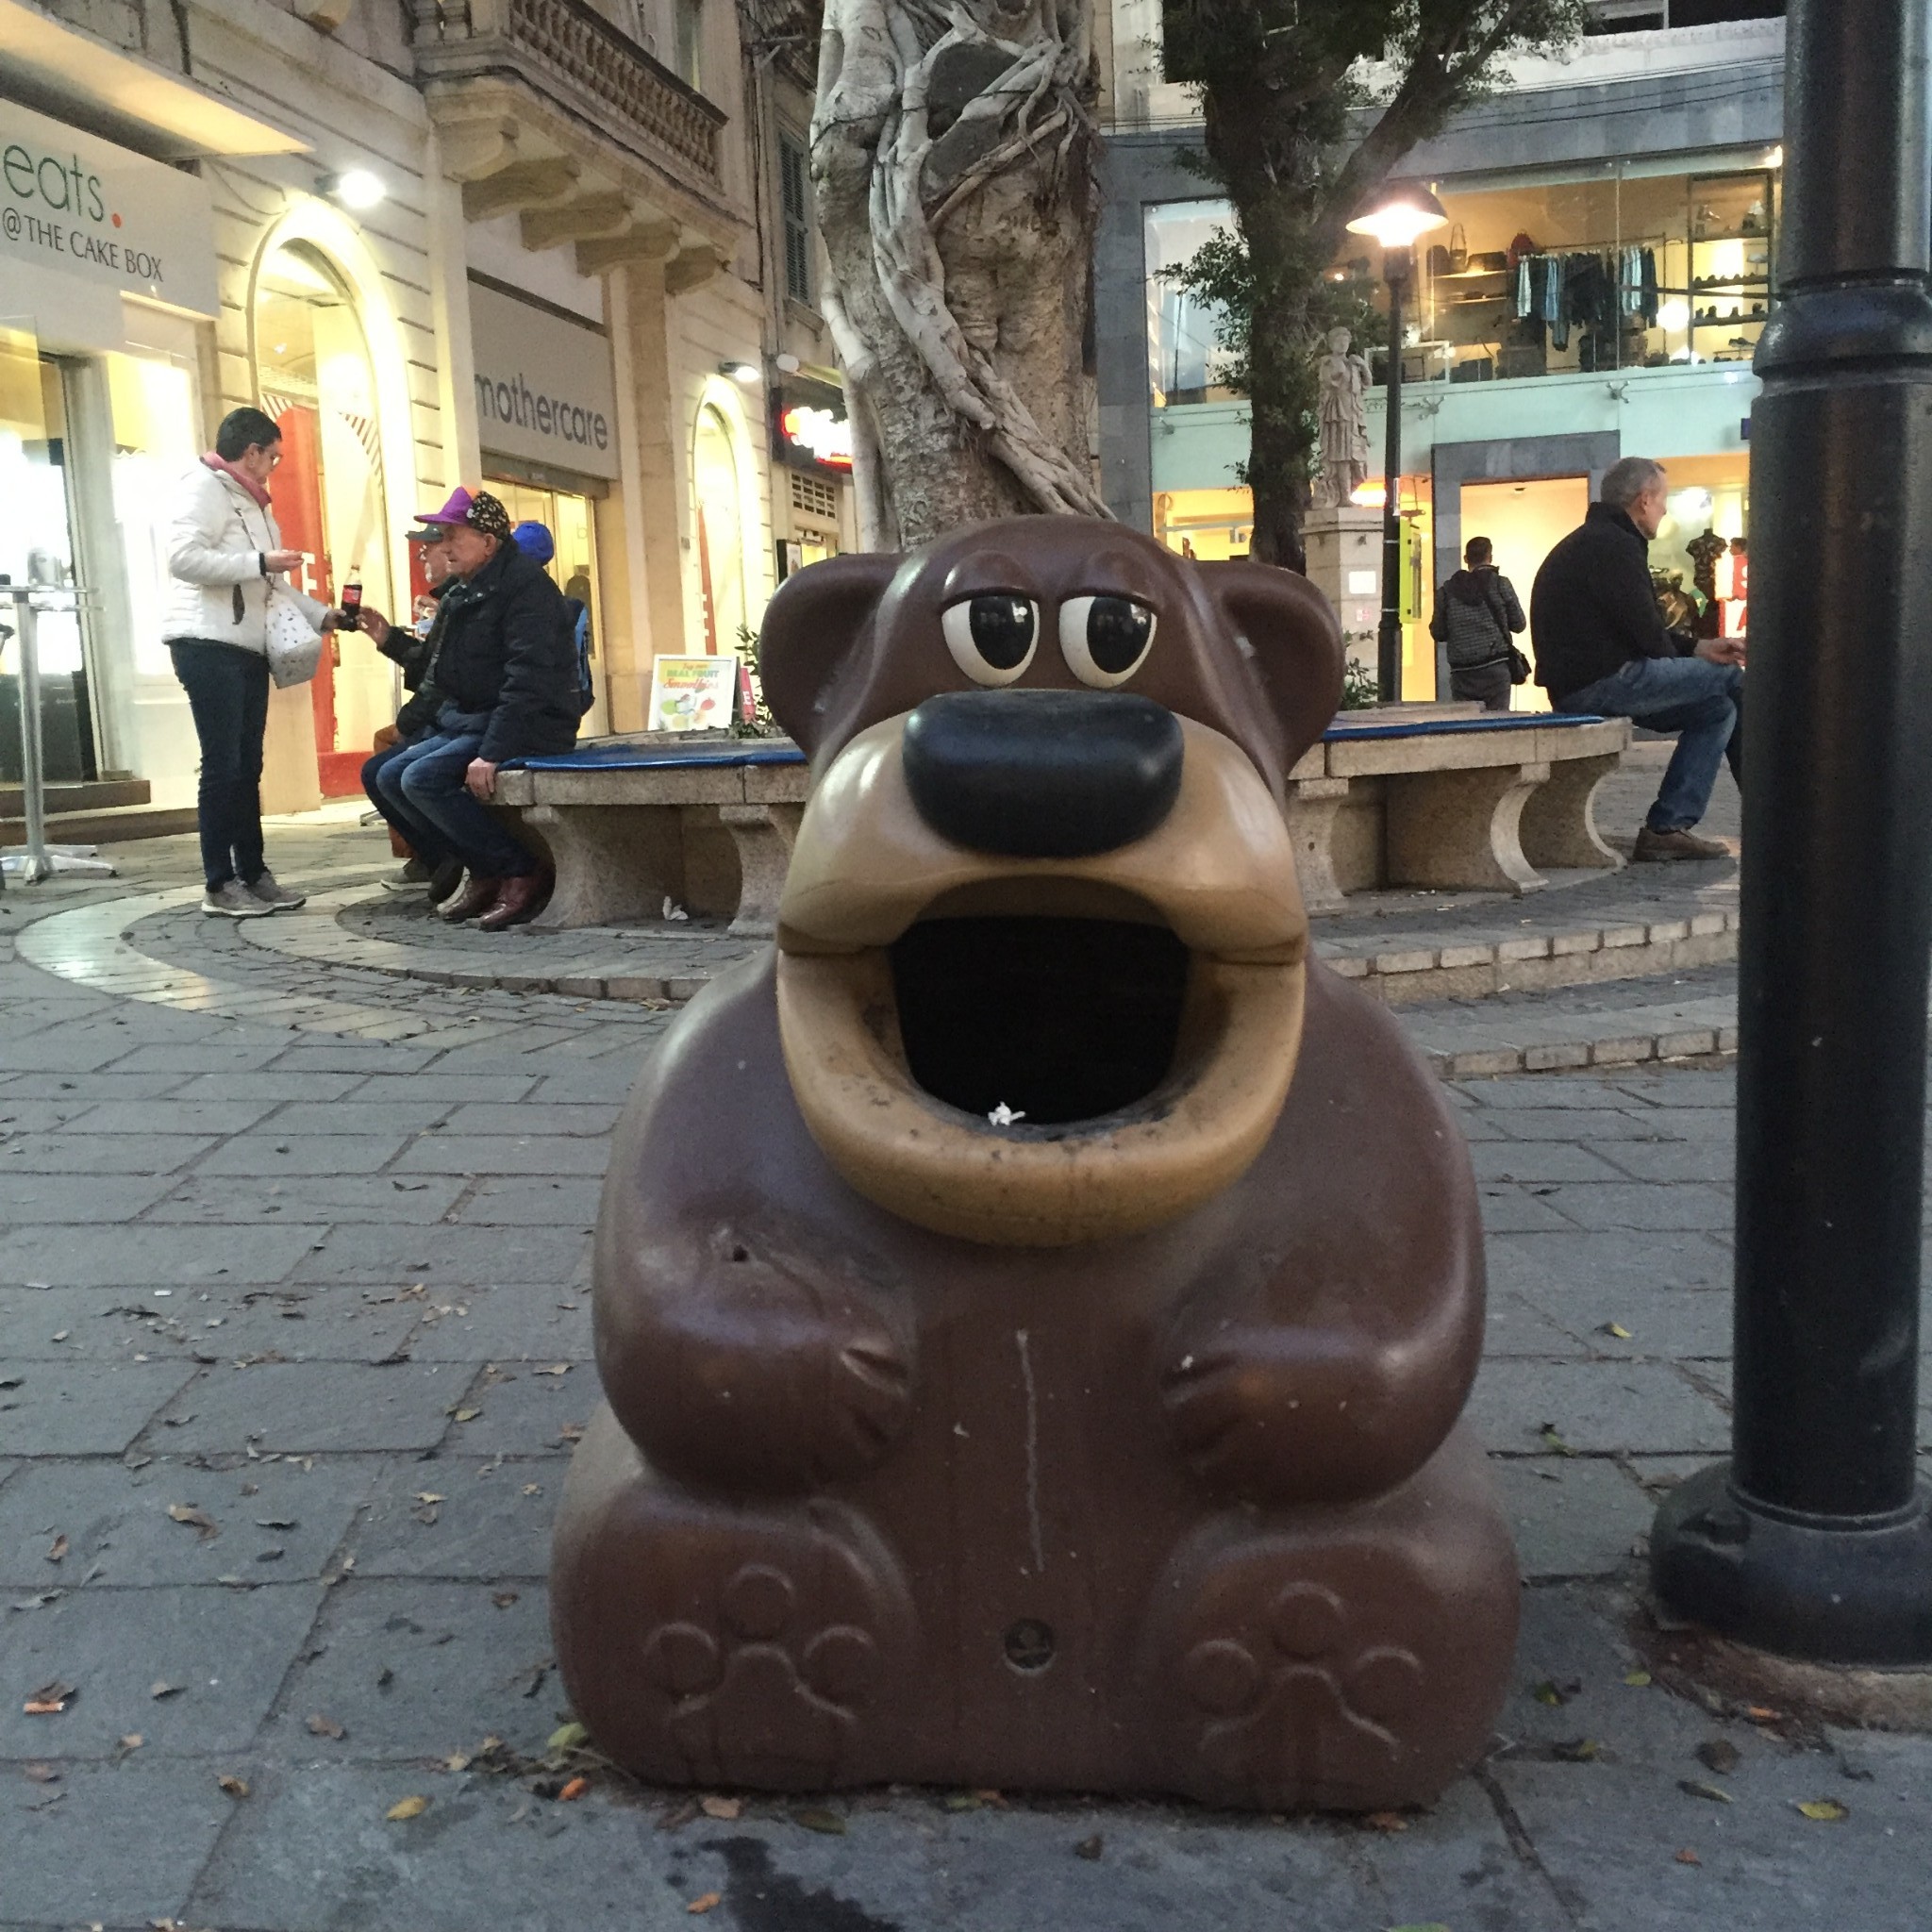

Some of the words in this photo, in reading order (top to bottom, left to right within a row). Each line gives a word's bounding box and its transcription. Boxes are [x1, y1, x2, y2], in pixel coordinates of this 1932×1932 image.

[3, 144, 122, 228] eats.
[70, 230, 119, 270] CAKE
[125, 248, 164, 283] BOX
[474, 372, 608, 451] mothercare
